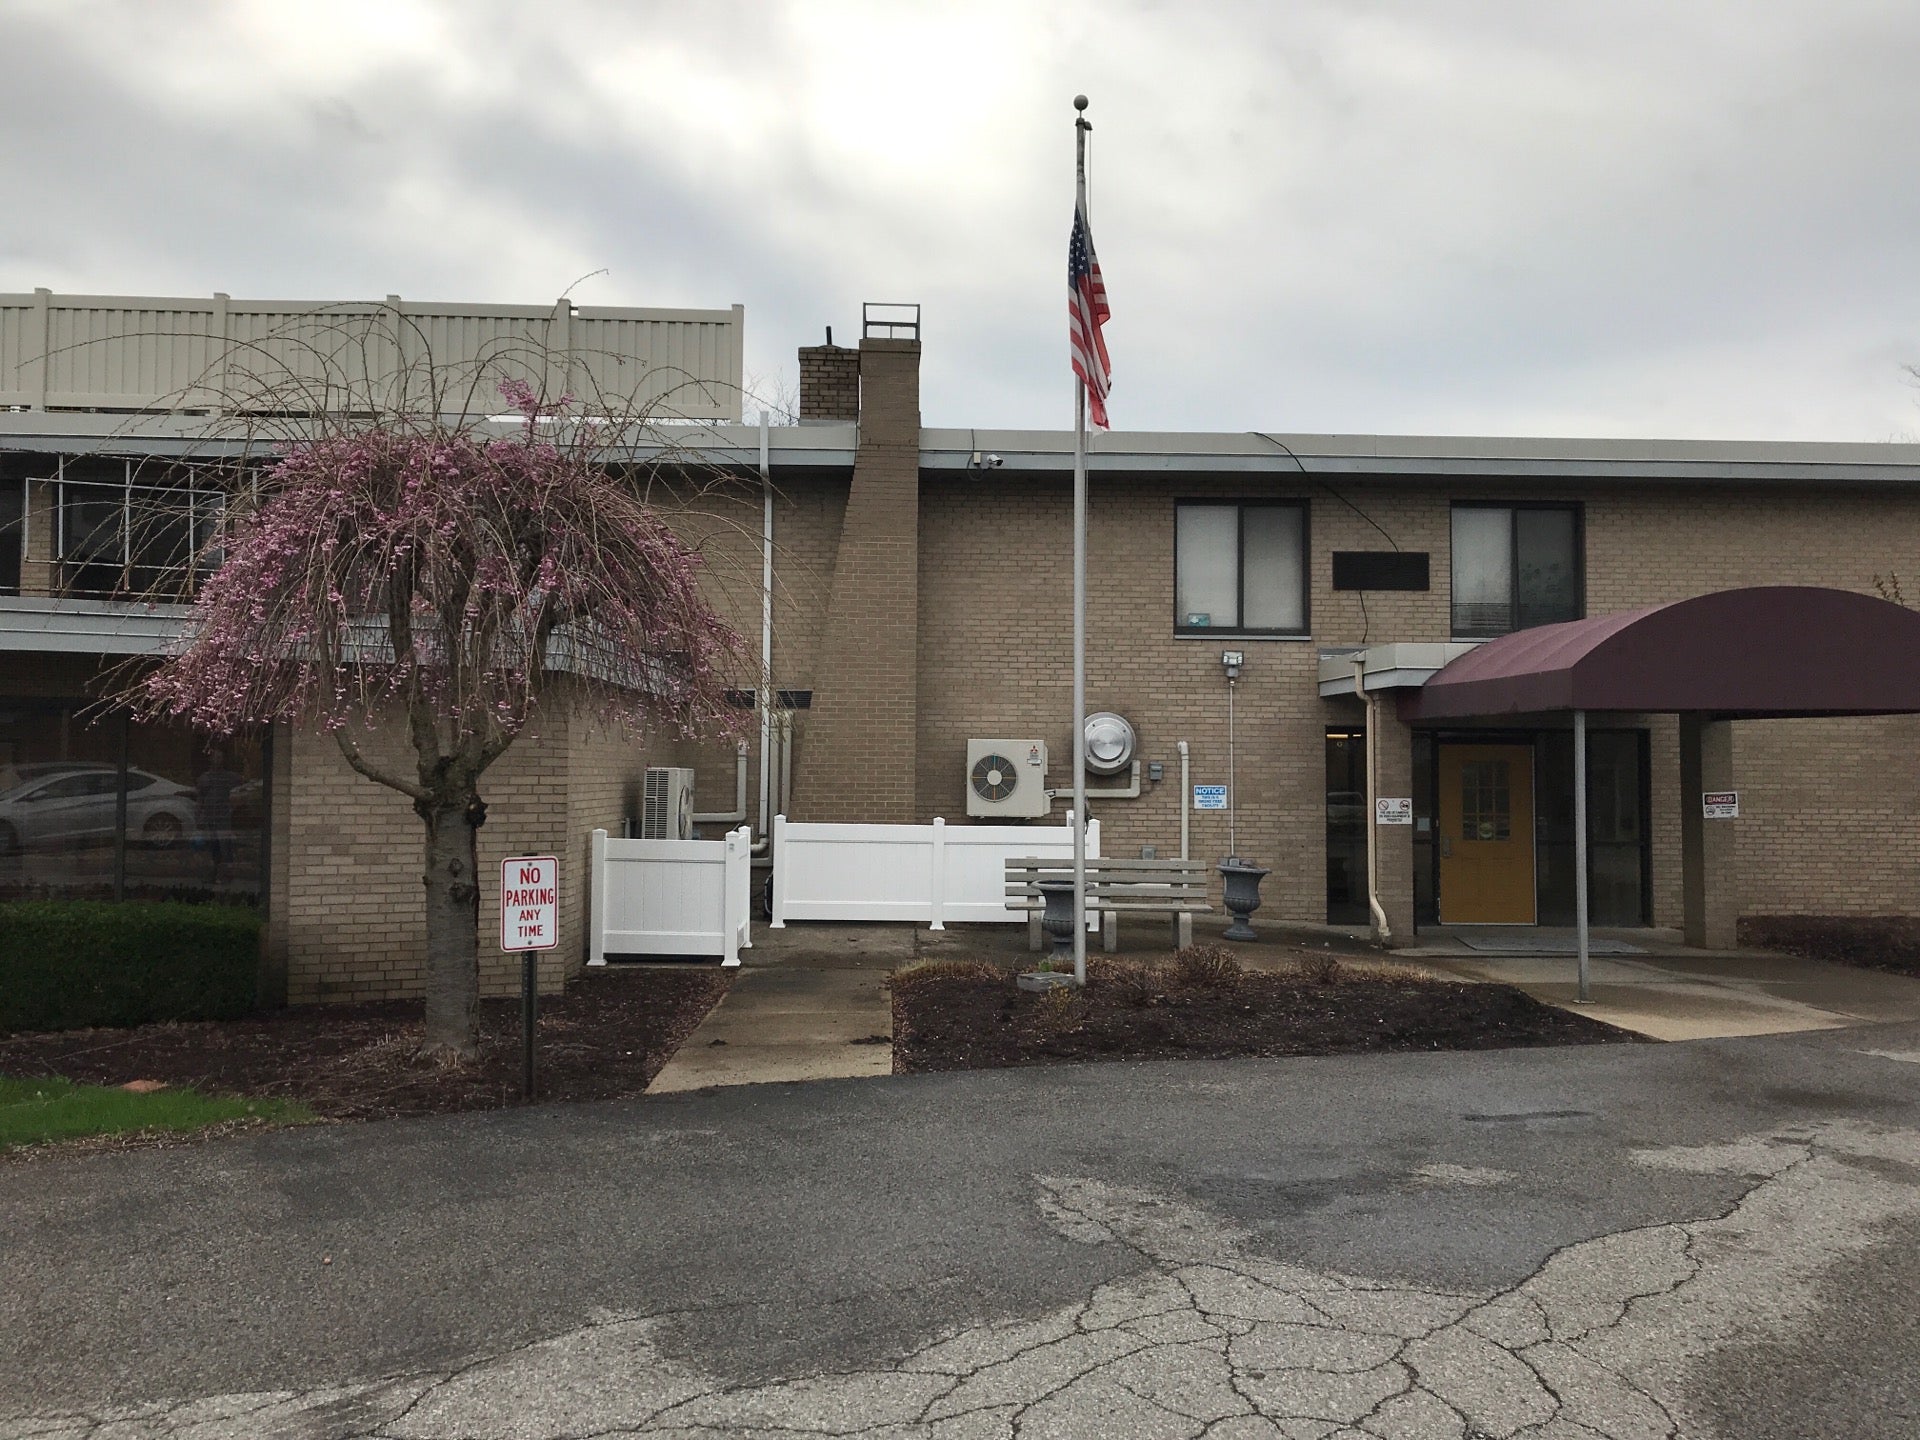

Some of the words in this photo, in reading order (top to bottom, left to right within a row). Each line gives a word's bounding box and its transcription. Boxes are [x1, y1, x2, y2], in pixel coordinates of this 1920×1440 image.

[520, 867, 541, 884] NO
[506, 888, 554, 907] PARKING
[519, 909, 541, 921] ANY
[517, 925, 543, 937] TIME
